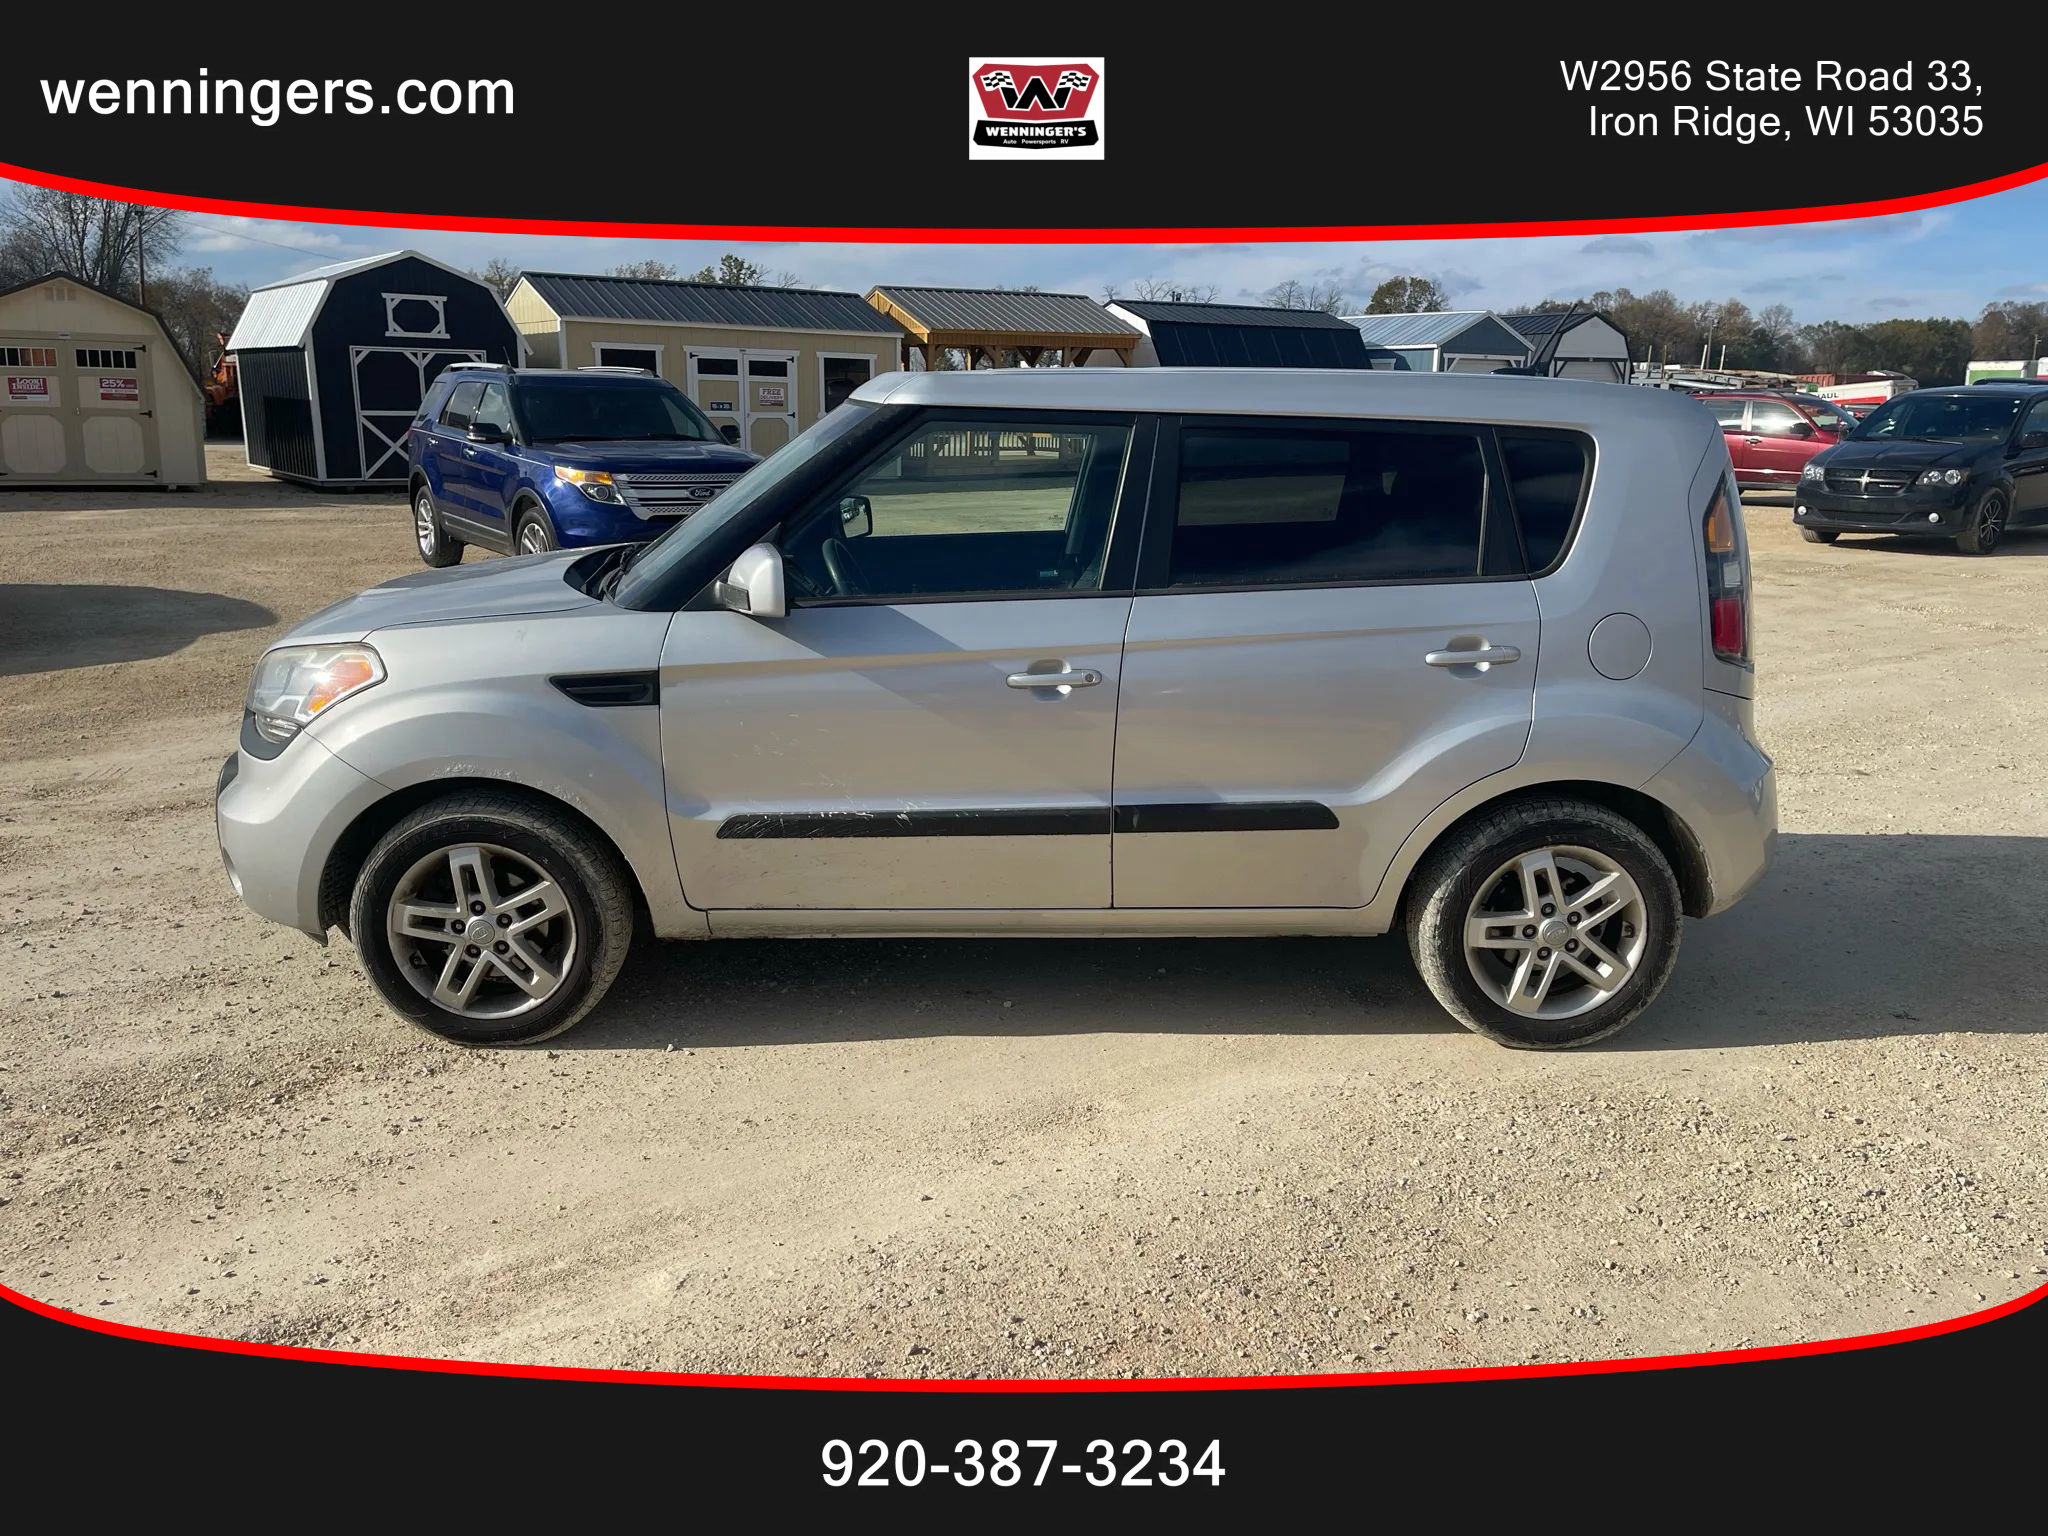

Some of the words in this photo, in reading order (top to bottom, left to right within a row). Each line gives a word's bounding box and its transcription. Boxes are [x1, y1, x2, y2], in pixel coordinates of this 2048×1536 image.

[101, 379, 125, 388] 25%
[762, 388, 781, 396] FREE
[694, 488, 711, 497] Ford
